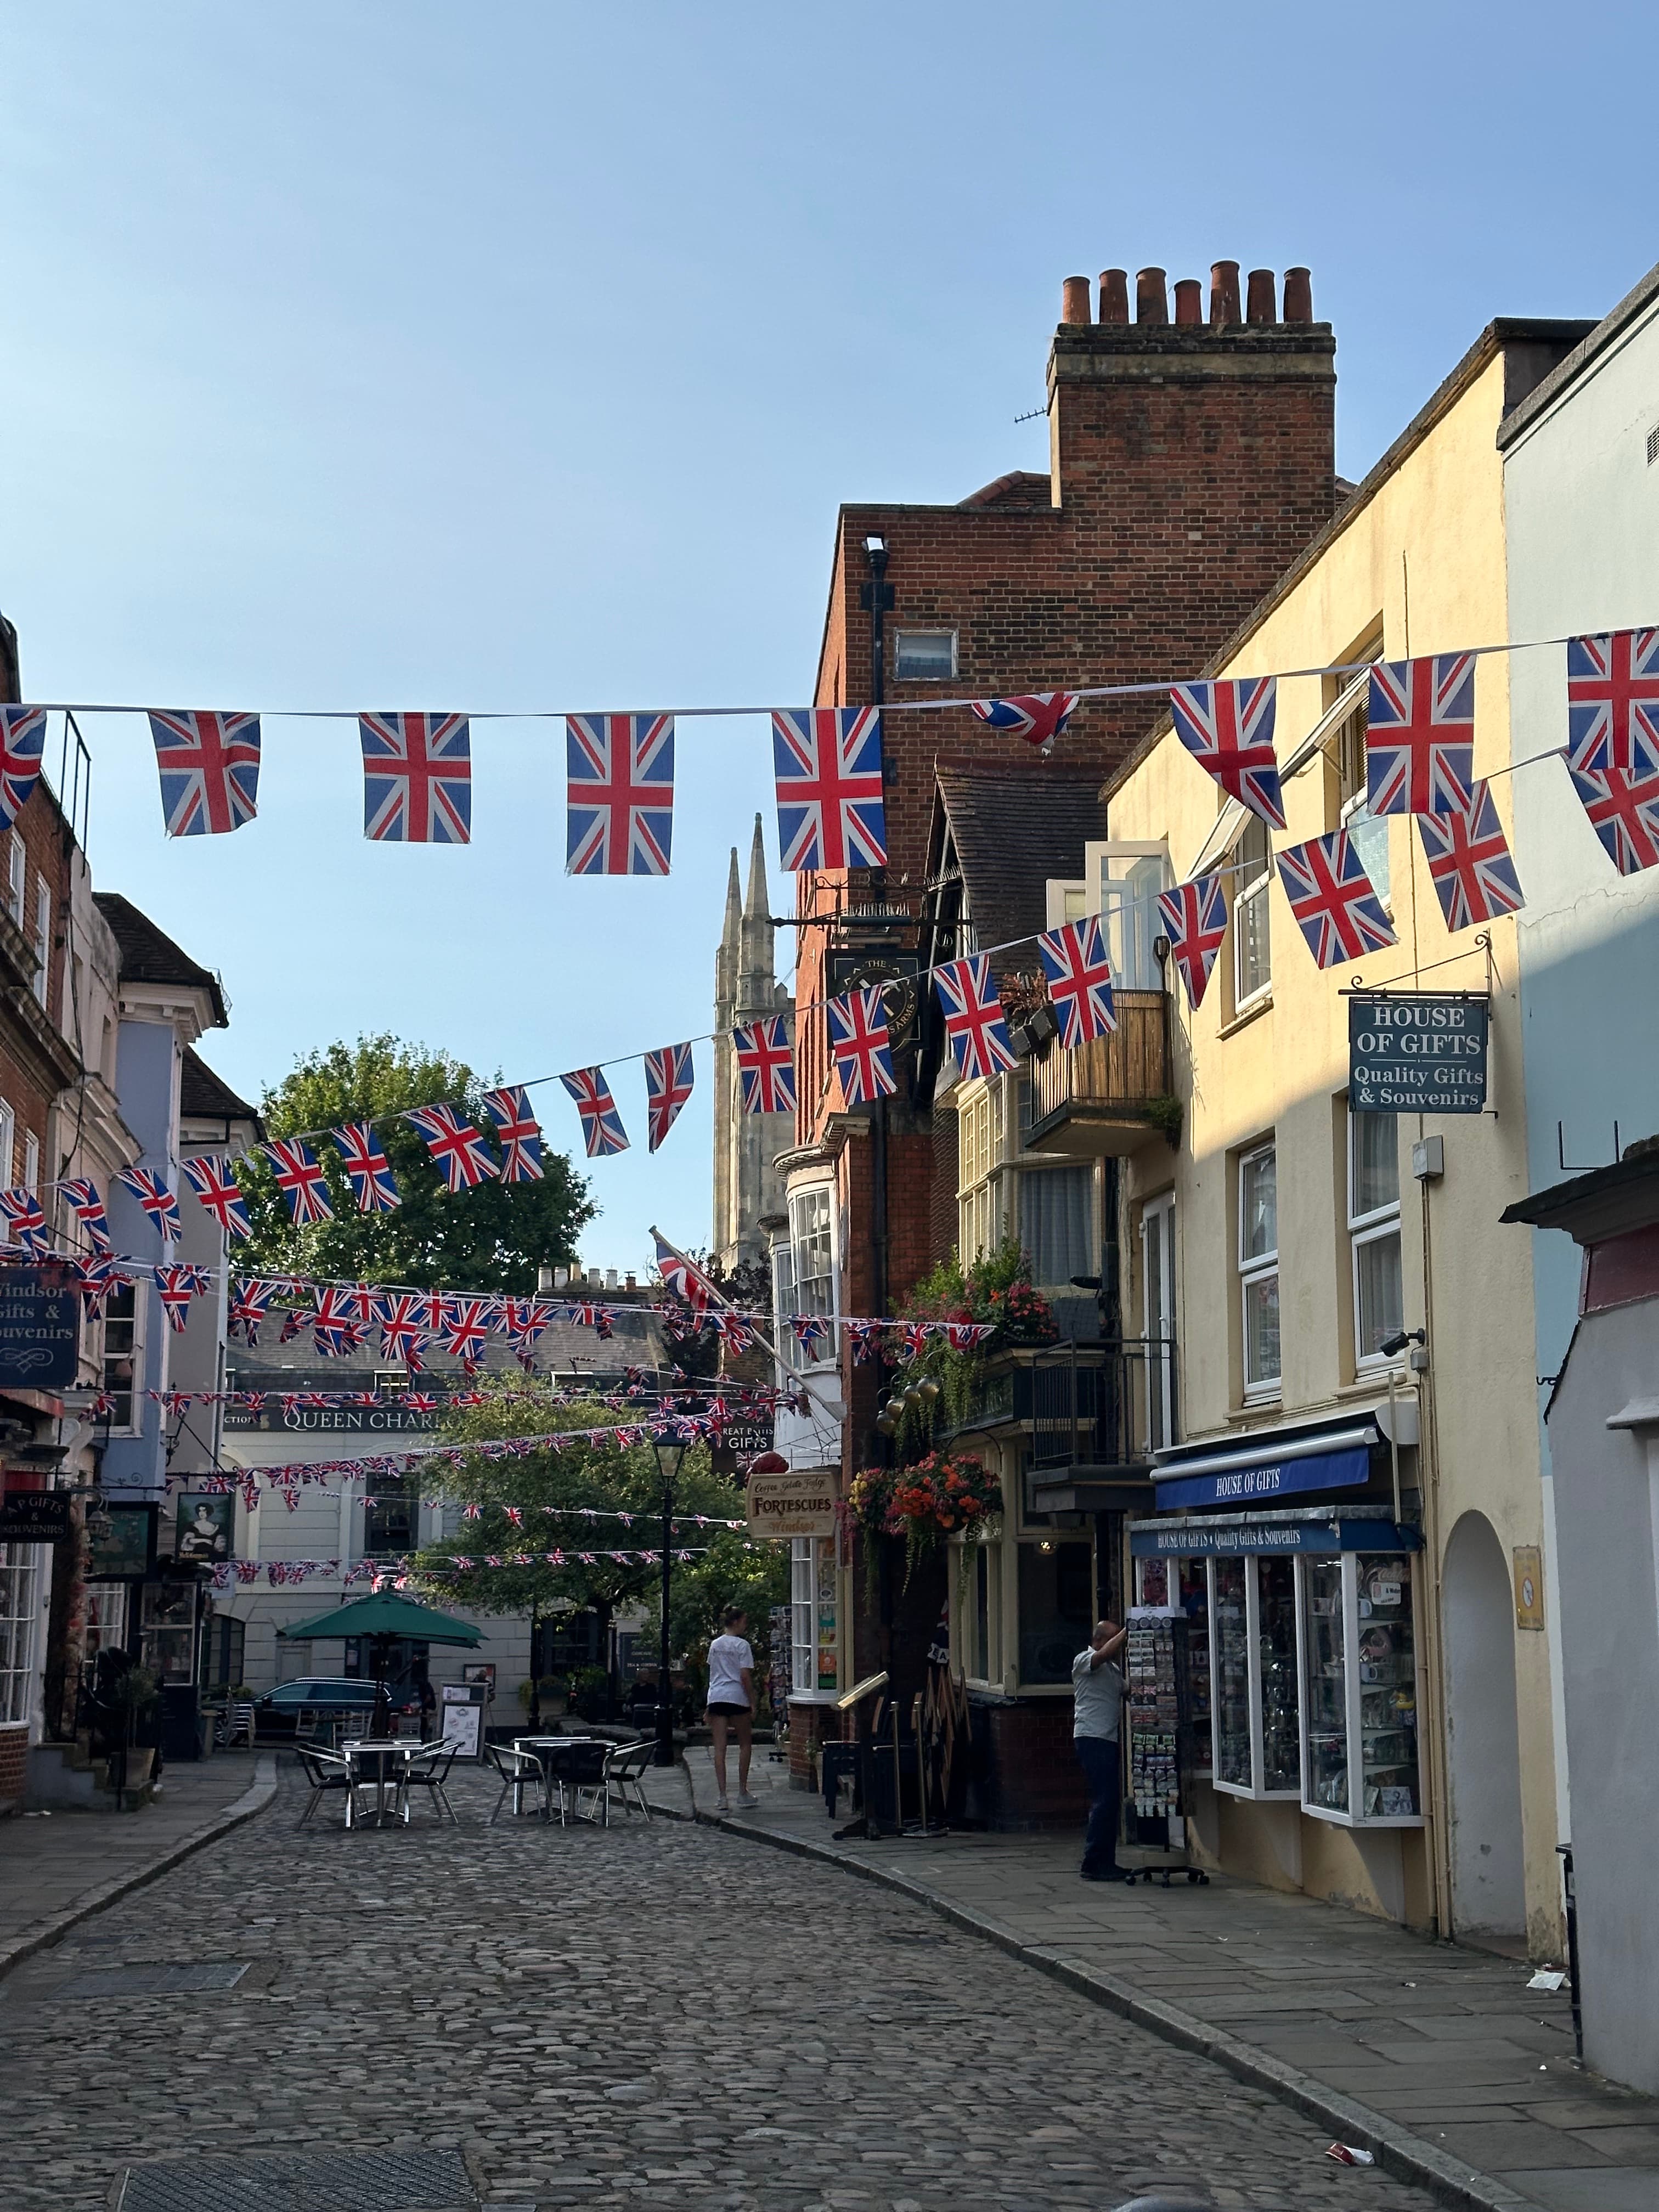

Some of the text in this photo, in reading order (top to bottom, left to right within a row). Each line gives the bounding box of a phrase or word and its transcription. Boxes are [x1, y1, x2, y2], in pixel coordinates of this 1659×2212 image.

[865, 960, 887, 968] THE
[895, 1004, 915, 1030] ARMS
[1373, 1007, 1465, 1028] HOUSE
[1357, 1033, 1481, 1055] OF GIFTS
[1354, 1066, 1484, 1087] Quality Gifts
[1359, 1088, 1479, 1105] & Souvenirs
[44, 1304, 61, 1319] &
[0, 1324, 74, 1339] uvenirs
[284, 1413, 363, 1431] QUEEN
[370, 1412, 452, 1429] CHARL
[755, 1483, 777, 1493] Coffee
[1216, 1468, 1280, 1497] HOUSE OF GIFTS
[29, 1497, 64, 1514] GIFTS
[753, 1497, 831, 1516] FORTESCUES
[31, 1511, 39, 1521] &
[1158, 1524, 1300, 1550] HOUSE OF GIFTS Quality Gifts & Souvenirs
